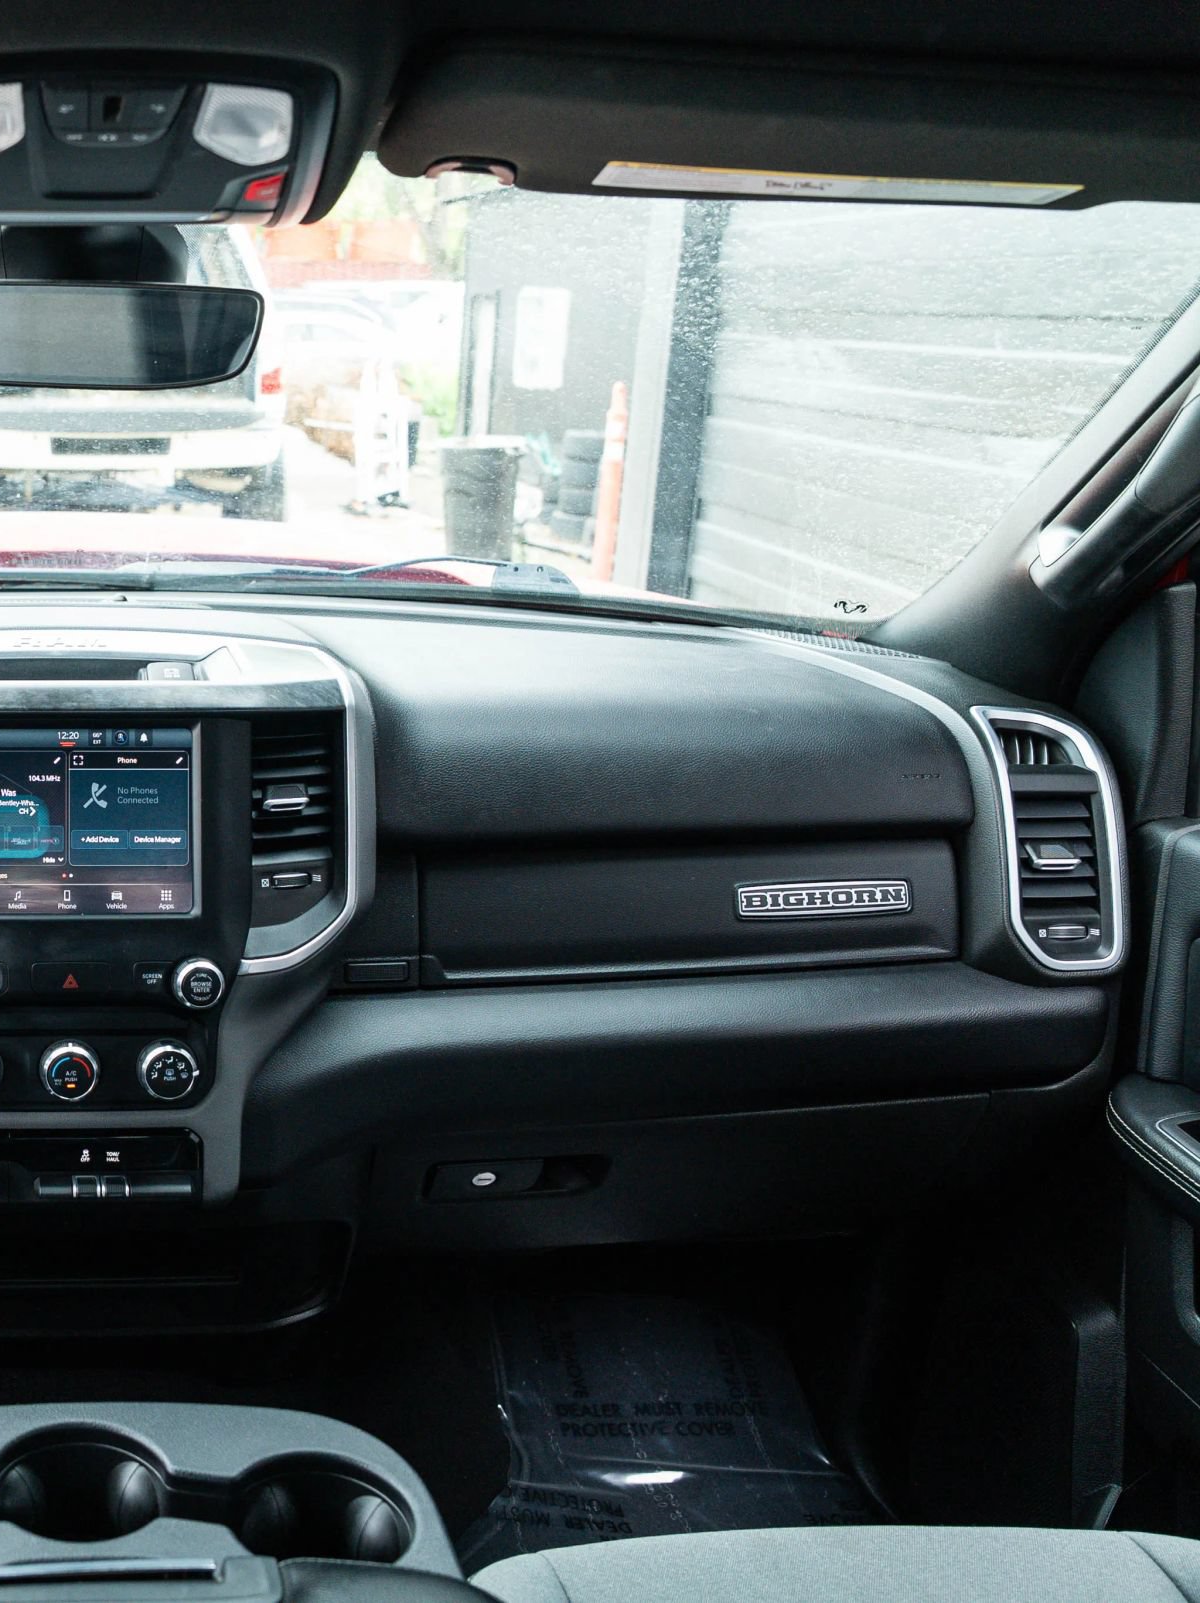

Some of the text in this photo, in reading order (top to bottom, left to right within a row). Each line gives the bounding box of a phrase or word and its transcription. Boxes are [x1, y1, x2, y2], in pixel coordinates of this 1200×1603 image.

[57, 731, 80, 740] 12:20
[1, 789, 17, 797] Was
[117, 796, 159, 804] Connected
[155, 836, 182, 844] Manager
[741, 887, 906, 911] BIGHORN
[158, 903, 174, 911] Apps
[555, 1400, 767, 1418] DEALER MUST REMOVE
[559, 1420, 735, 1437] PROTECTIVE COVER
